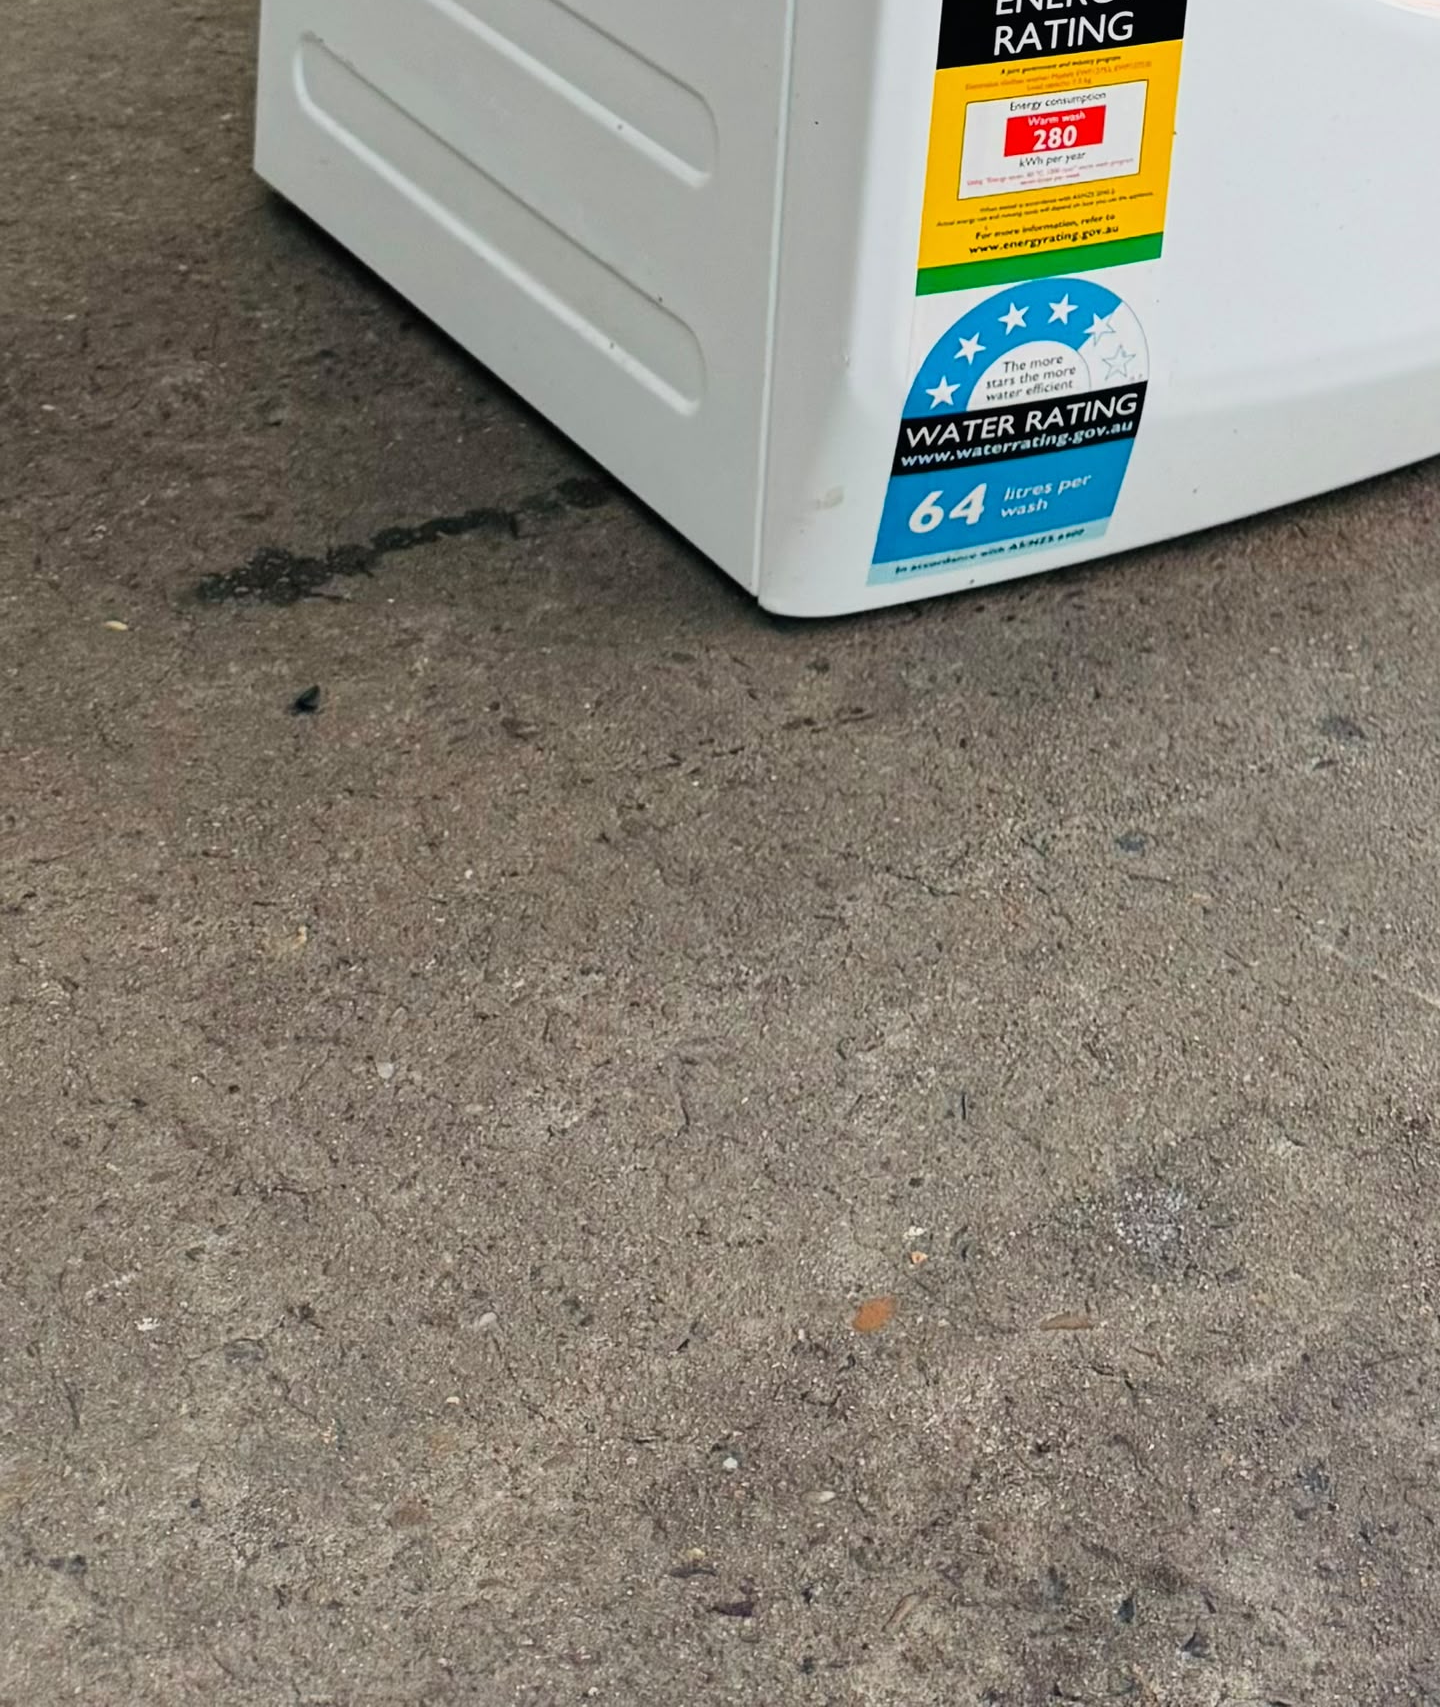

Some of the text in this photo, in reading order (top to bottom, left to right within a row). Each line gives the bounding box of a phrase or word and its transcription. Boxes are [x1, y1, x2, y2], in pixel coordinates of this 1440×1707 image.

[994, 11, 1134, 56] RATING
[1010, 92, 1107, 111] Energy consumption
[1028, 110, 1086, 126] Warm wash
[1032, 125, 1078, 152] 280
[1019, 151, 1086, 168] kWh per year
[969, 225, 1119, 255] www.energyrating.gov.au
[975, 213, 1116, 240] For more information, refer to
[1003, 355, 1063, 373] The more
[986, 366, 1076, 390] stars the more
[986, 380, 1073, 401] water efficient
[906, 393, 1138, 449] WATER RATING
[901, 420, 1134, 467] www.waterrating.gov.au
[1004, 475, 1092, 502] litres per
[908, 483, 988, 534] 64
[1001, 498, 1048, 519] wash
